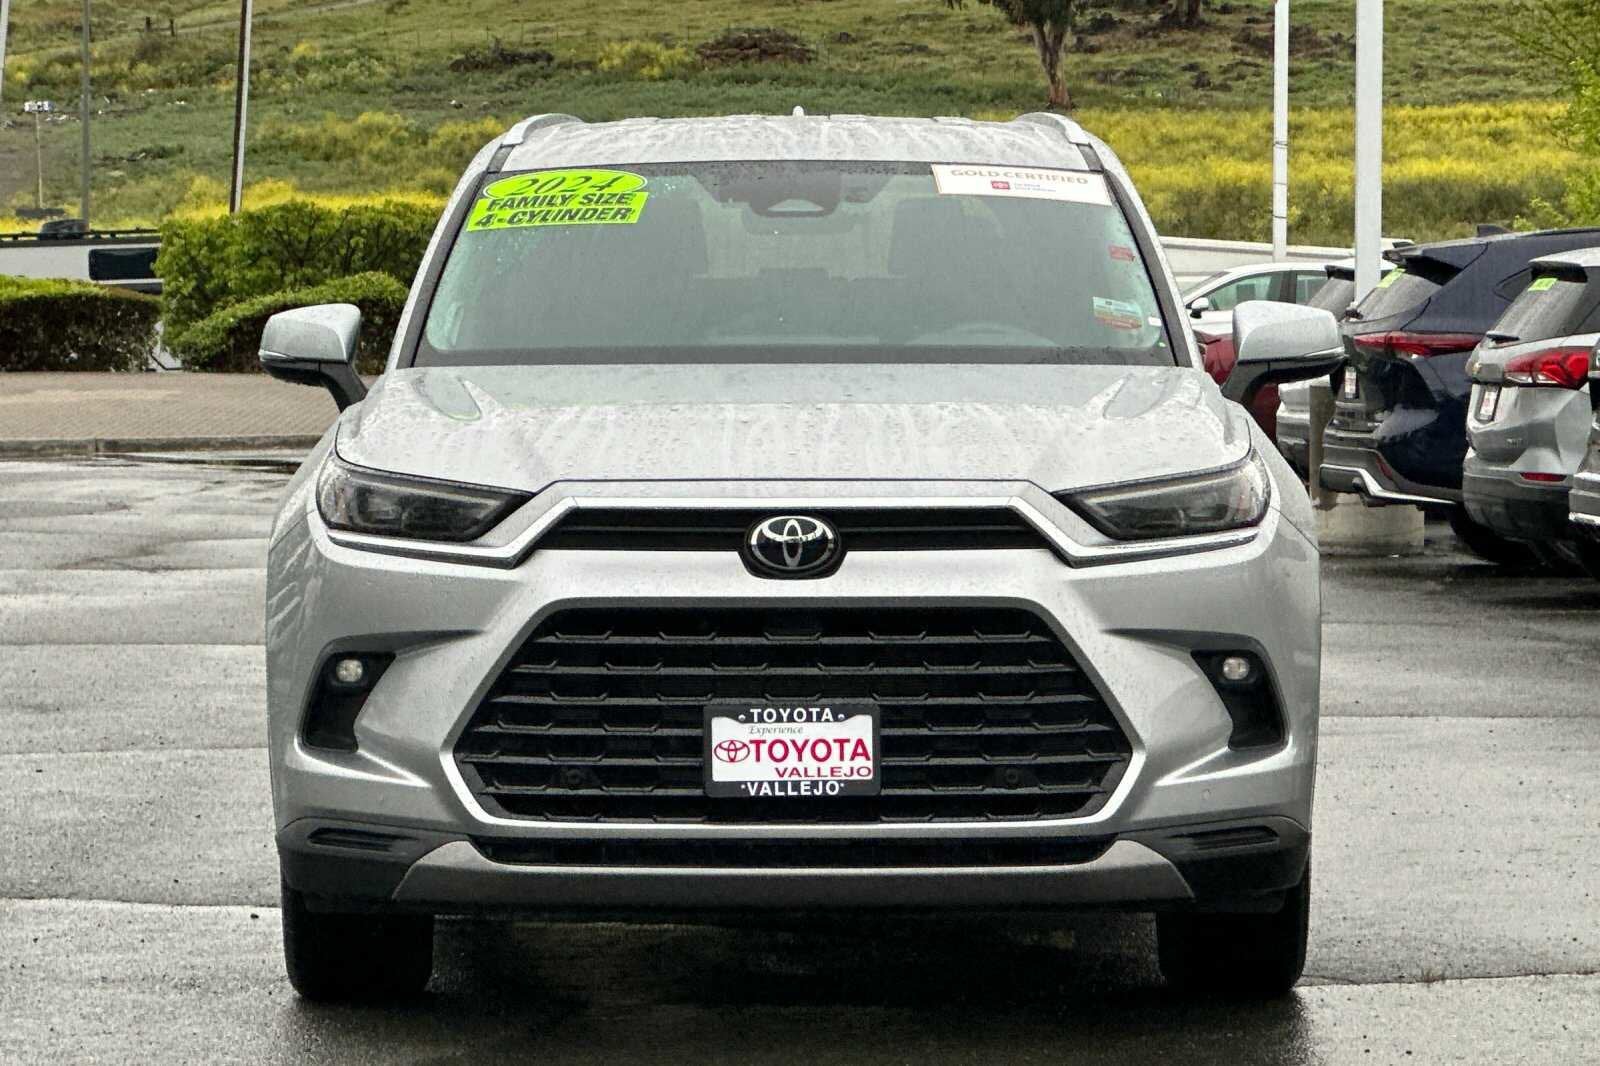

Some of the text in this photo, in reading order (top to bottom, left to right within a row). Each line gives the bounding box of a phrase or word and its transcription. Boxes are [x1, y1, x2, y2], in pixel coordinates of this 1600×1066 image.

[507, 175, 624, 195] 2024
[951, 169, 1089, 185] GOLD CERTIFIED
[486, 192, 635, 212] FAMILY SIZE
[750, 708, 834, 723] TOYOTA
[750, 725, 804, 736] Experience
[749, 738, 871, 763] TOYOTA
[775, 766, 872, 778] VALLEJO
[747, 781, 840, 797] VALLEJO
